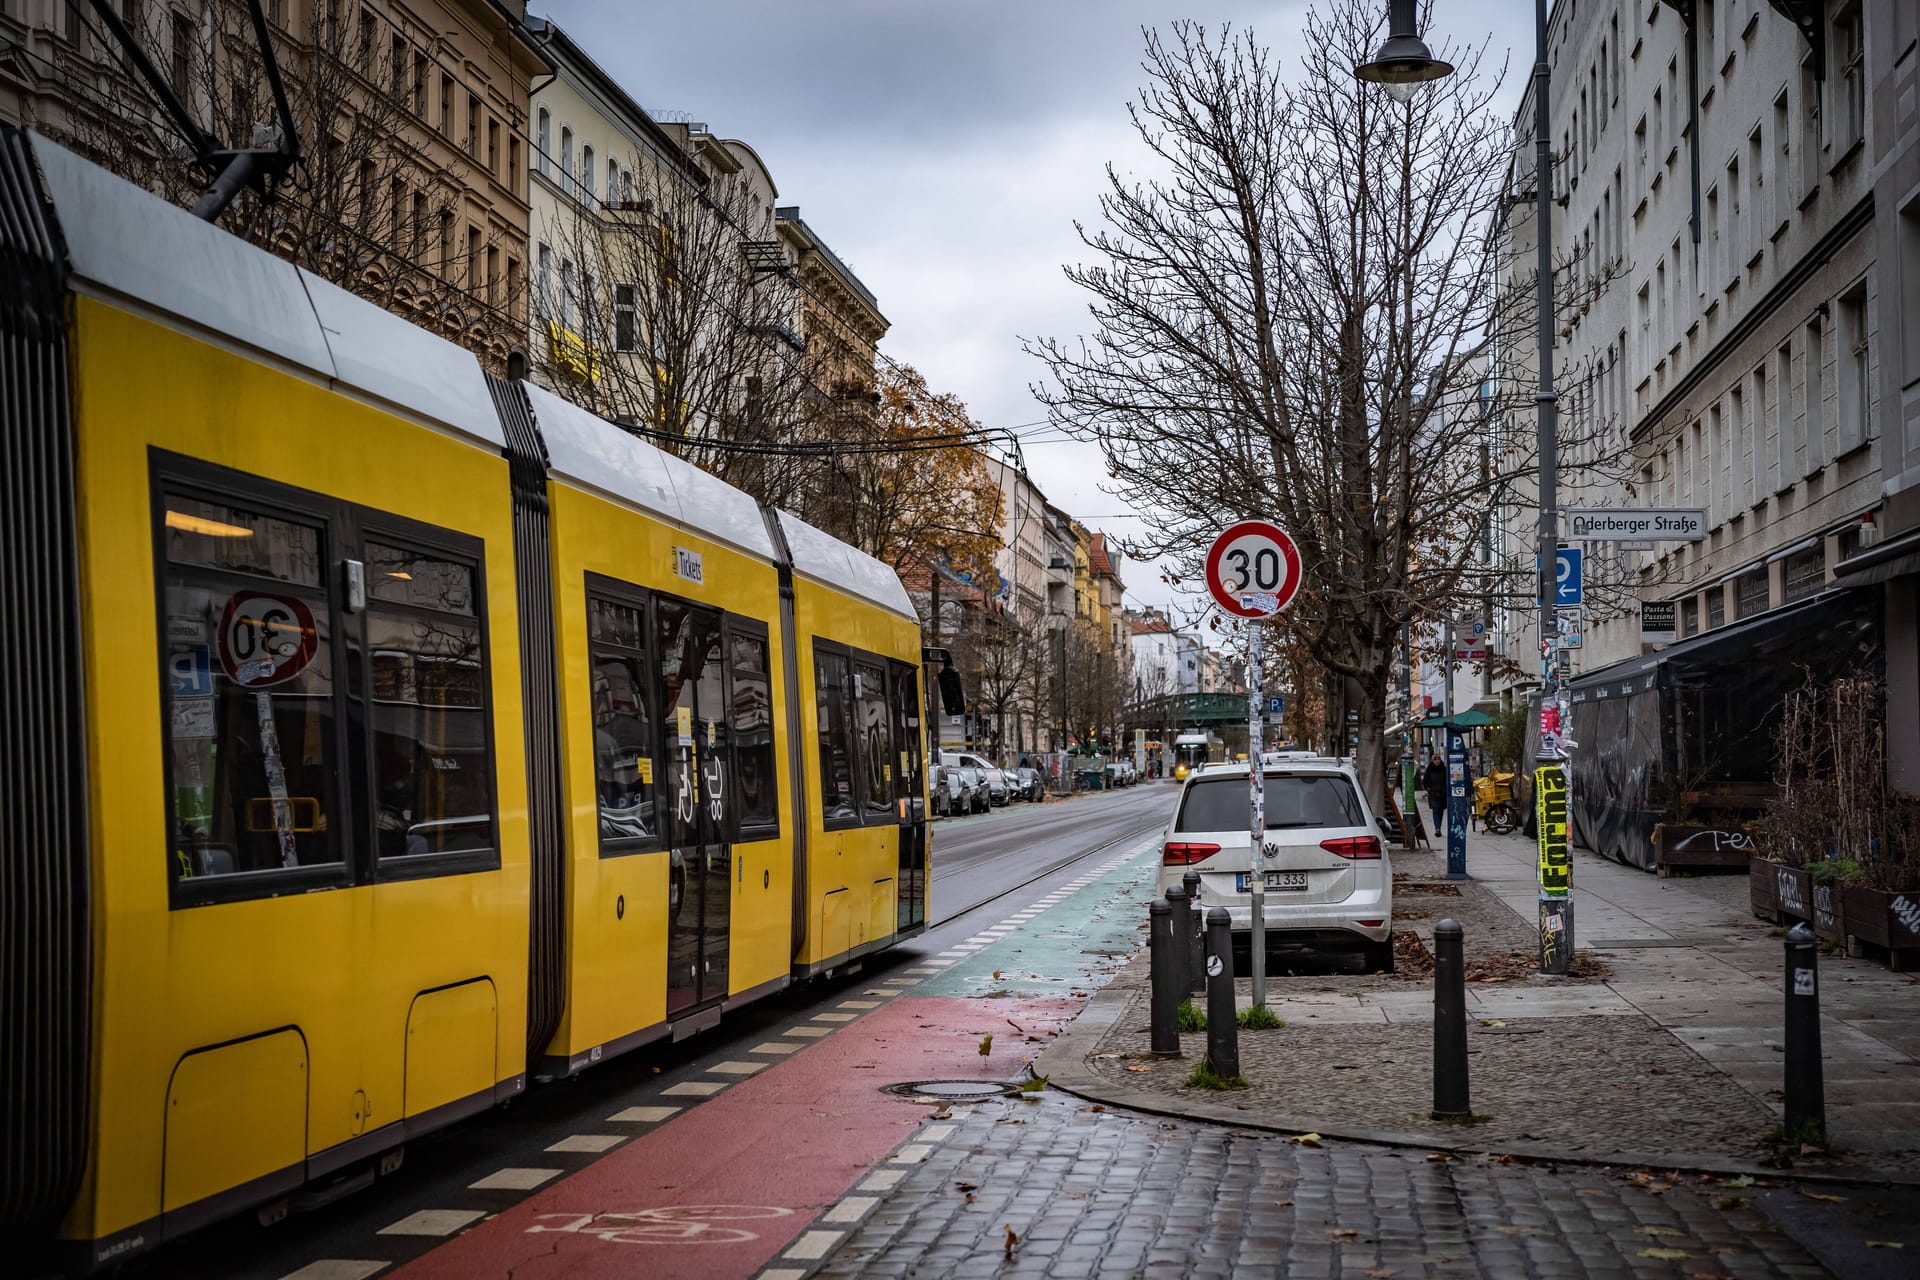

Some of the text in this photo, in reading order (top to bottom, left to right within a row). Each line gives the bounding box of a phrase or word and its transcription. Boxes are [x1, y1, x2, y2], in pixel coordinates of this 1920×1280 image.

[1574, 516, 1697, 533] Oderberger Straße
[679, 551, 702, 582] Tickets
[1226, 548, 1279, 591] 30
[1271, 699, 1279, 711] P
[1453, 737, 1462, 750] P
[1543, 769, 1568, 888] Forma
[1284, 873, 1305, 885] 333
